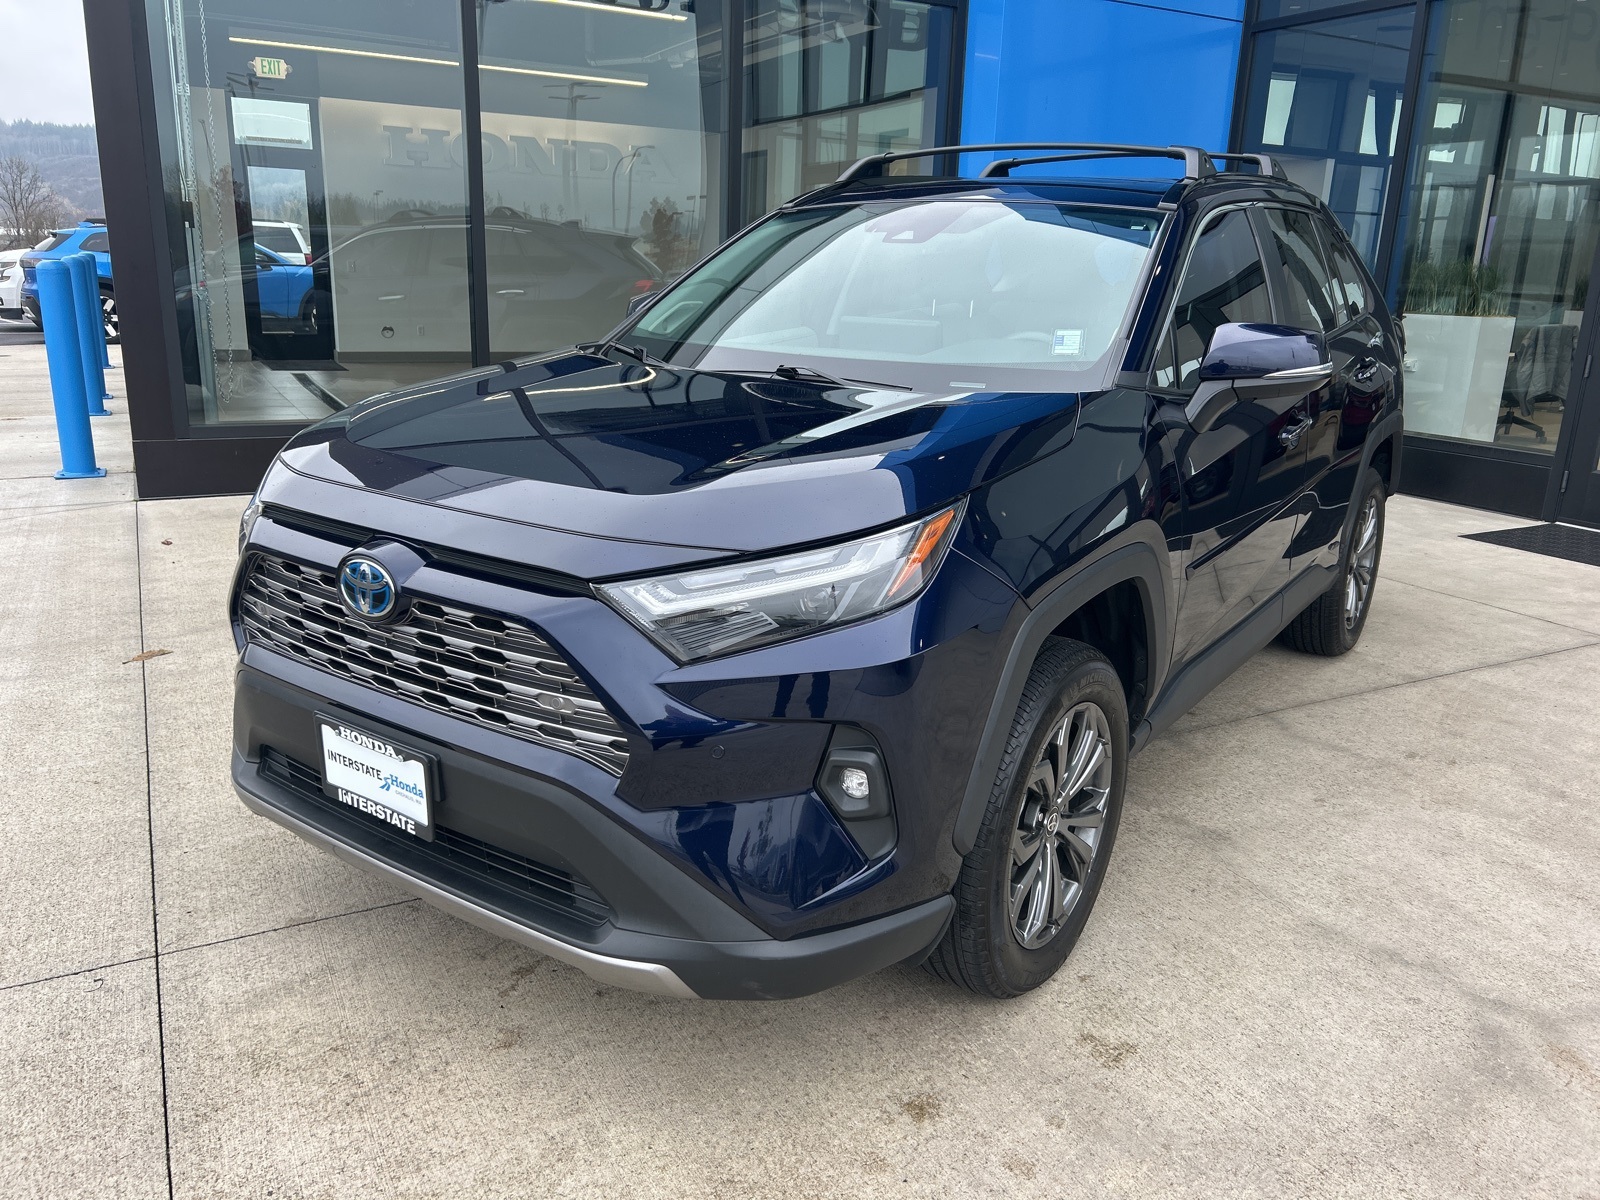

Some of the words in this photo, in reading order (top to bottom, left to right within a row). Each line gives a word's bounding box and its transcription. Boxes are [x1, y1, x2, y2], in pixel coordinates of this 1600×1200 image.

[260, 59, 281, 75] EXIT
[382, 124, 680, 184] HONDA
[338, 726, 398, 758] HONDA
[327, 749, 382, 781] INTERSTATE
[389, 774, 424, 799] Honda
[338, 788, 416, 835] INTERSTATE
